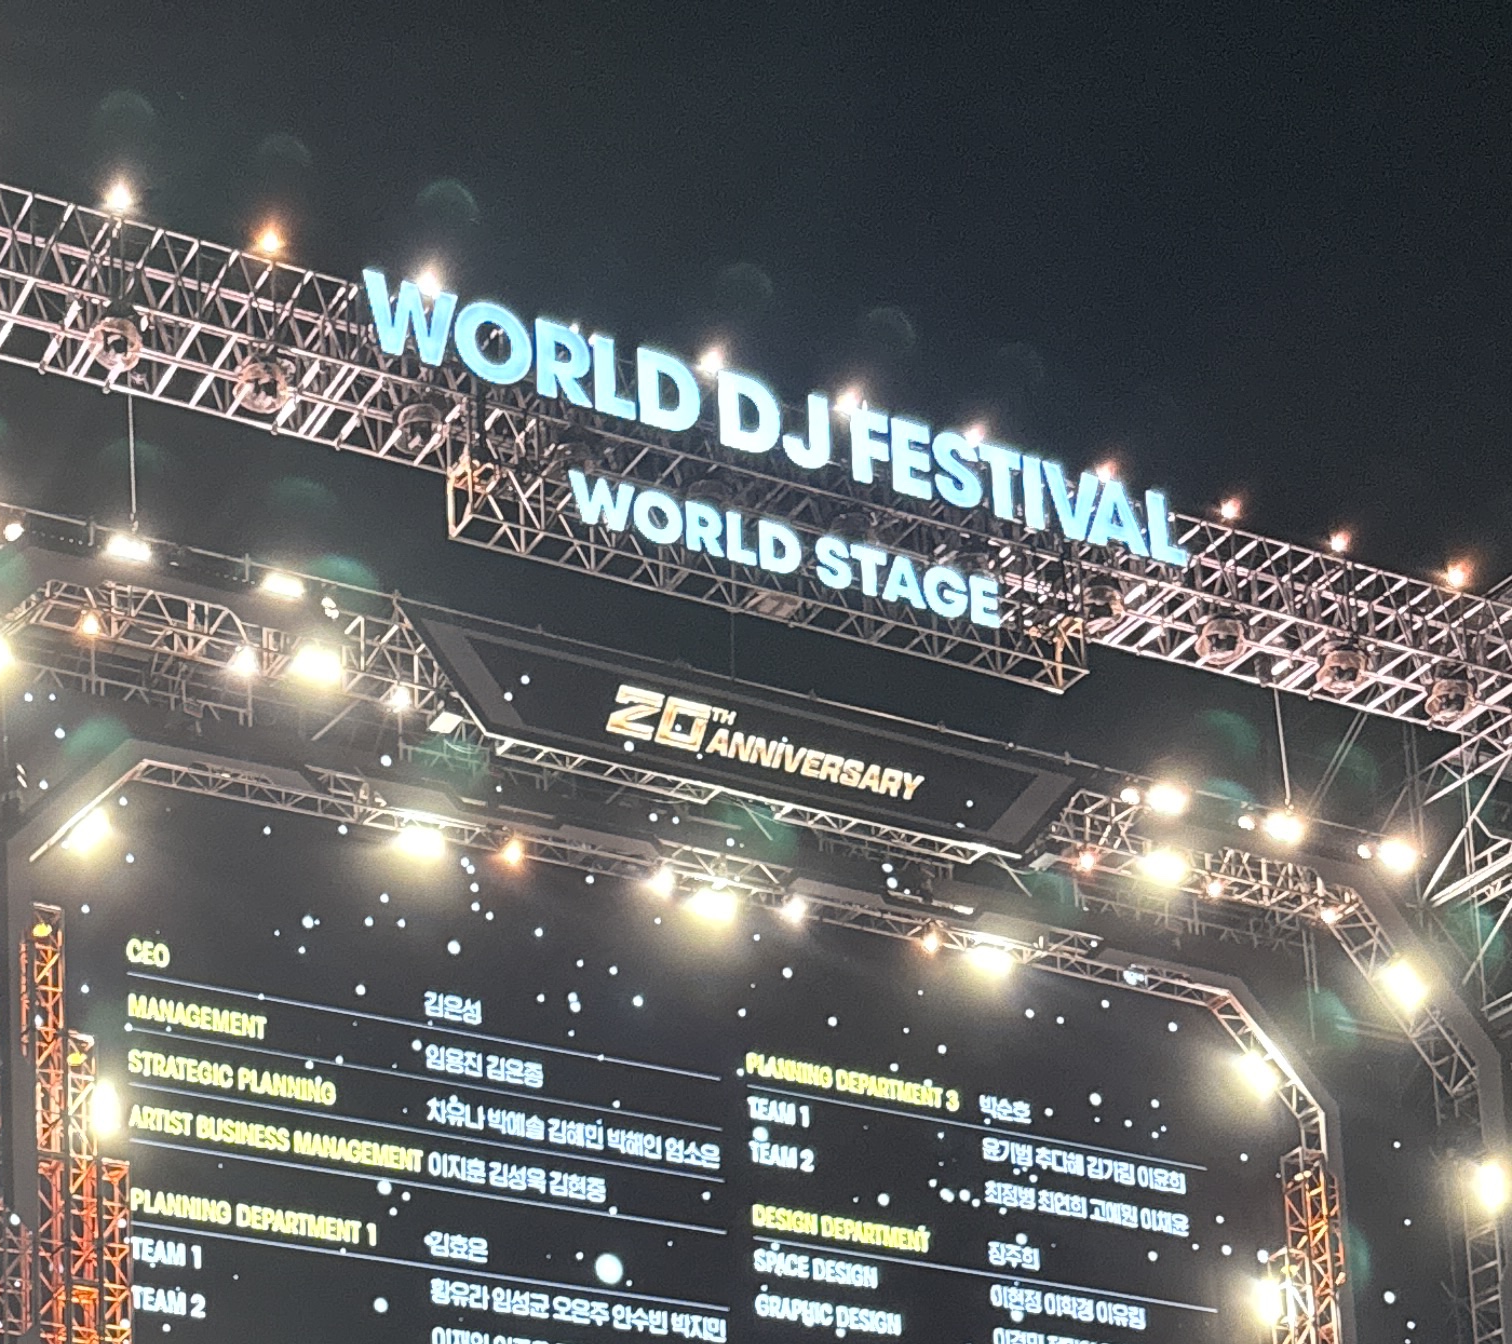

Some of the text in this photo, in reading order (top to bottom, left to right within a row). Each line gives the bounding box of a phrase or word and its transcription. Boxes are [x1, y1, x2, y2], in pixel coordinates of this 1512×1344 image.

[363, 269, 1189, 568] WORLD DJ FESTIVAL
[569, 469, 1001, 627] WORLD STAGE
[706, 728, 925, 800] ANNIVERSARY
[126, 939, 170, 968] CEO
[128, 993, 267, 1039] MANAGEMENT
[128, 1049, 336, 1105] STRATEGIC PLANNING
[746, 1052, 960, 1112] PLANNING DEPARTMENT 3
[748, 1096, 810, 1128] TEAM 1
[129, 1105, 423, 1173] ARTIST BUSINESS MANAGEMENT
[749, 1141, 814, 1172] TEAM 2
[131, 1188, 377, 1246] PLANNING DEPARTMENT 1
[752, 1204, 930, 1252] DESIGN DEPARTMENT
[131, 1237, 202, 1269] TEAM 1
[754, 1249, 878, 1289] SPACE DESIGN
[131, 1285, 206, 1318] TEAM 2
[755, 1294, 901, 1336] GRAPHIC DESIGN
